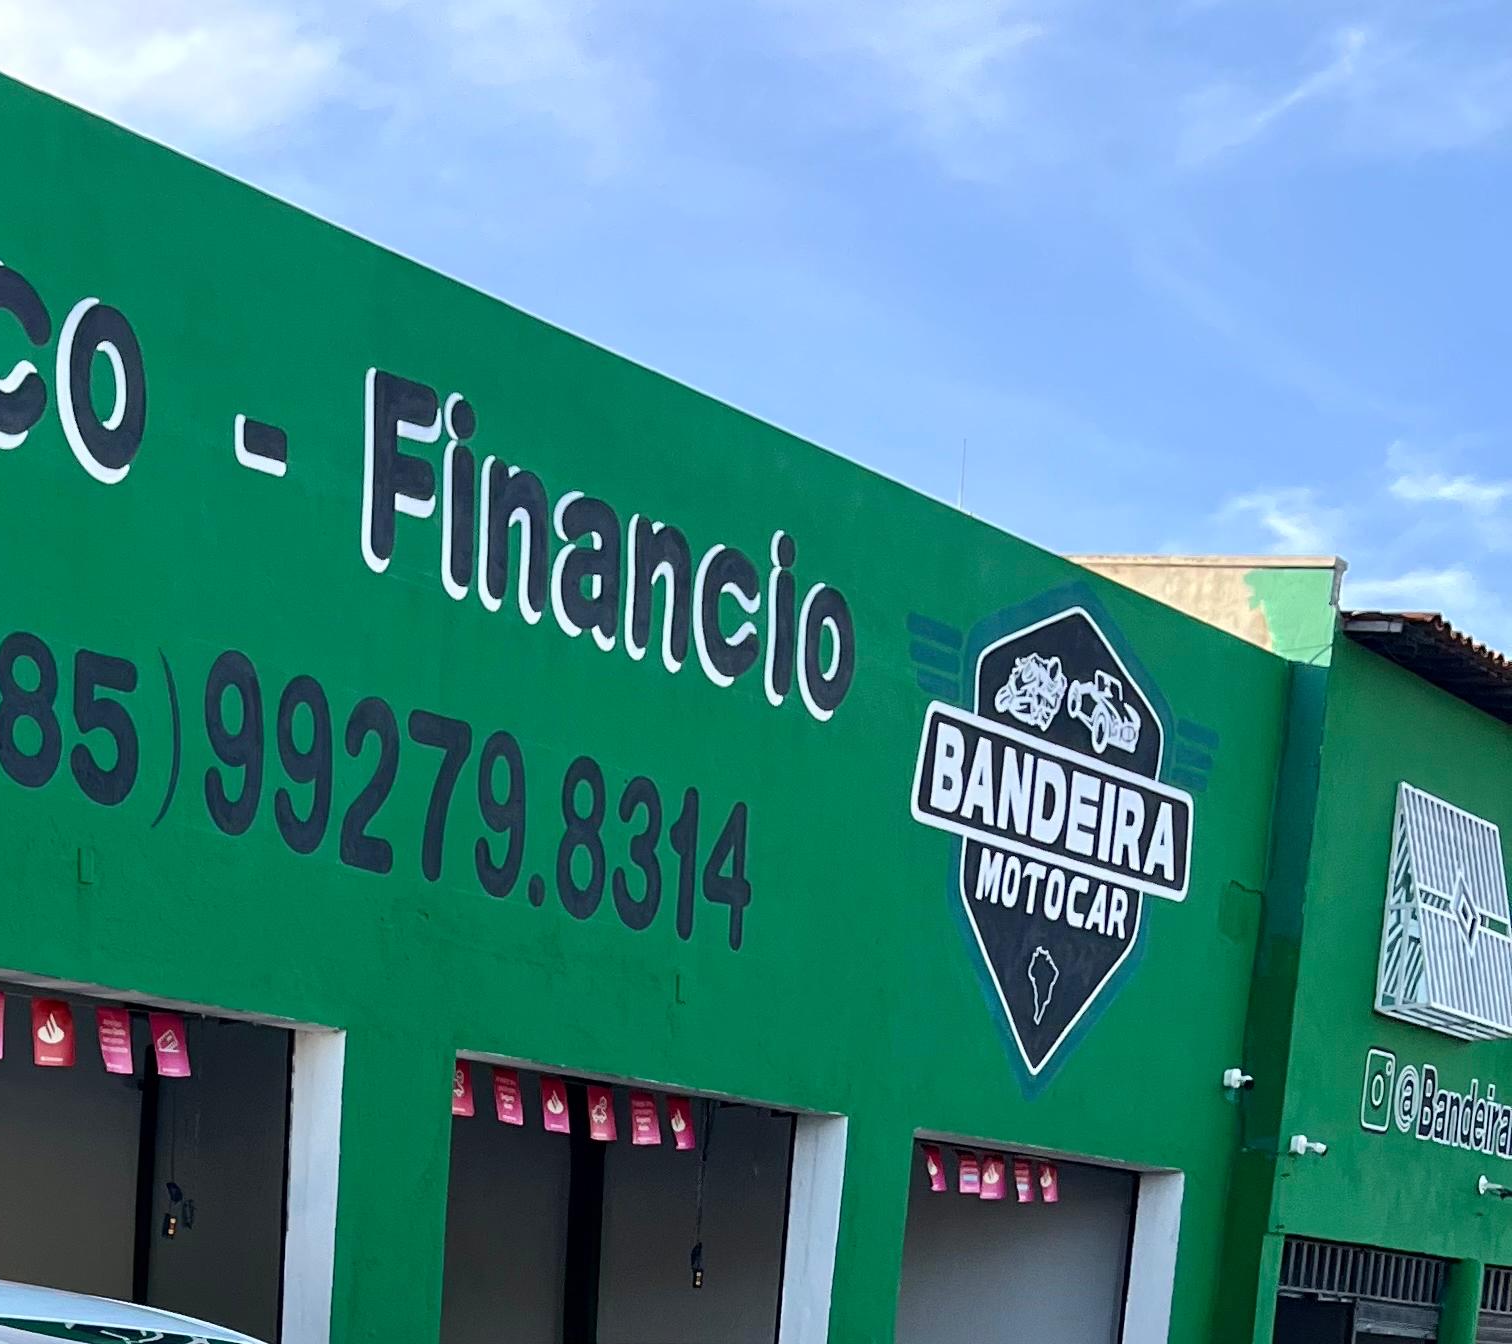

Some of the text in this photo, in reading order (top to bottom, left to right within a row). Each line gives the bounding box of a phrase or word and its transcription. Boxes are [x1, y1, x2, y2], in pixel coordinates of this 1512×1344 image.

[360, 367, 857, 722] Financio
[929, 721, 1176, 881] BANDEIRA
[974, 848, 1130, 940] MOTOCAR
